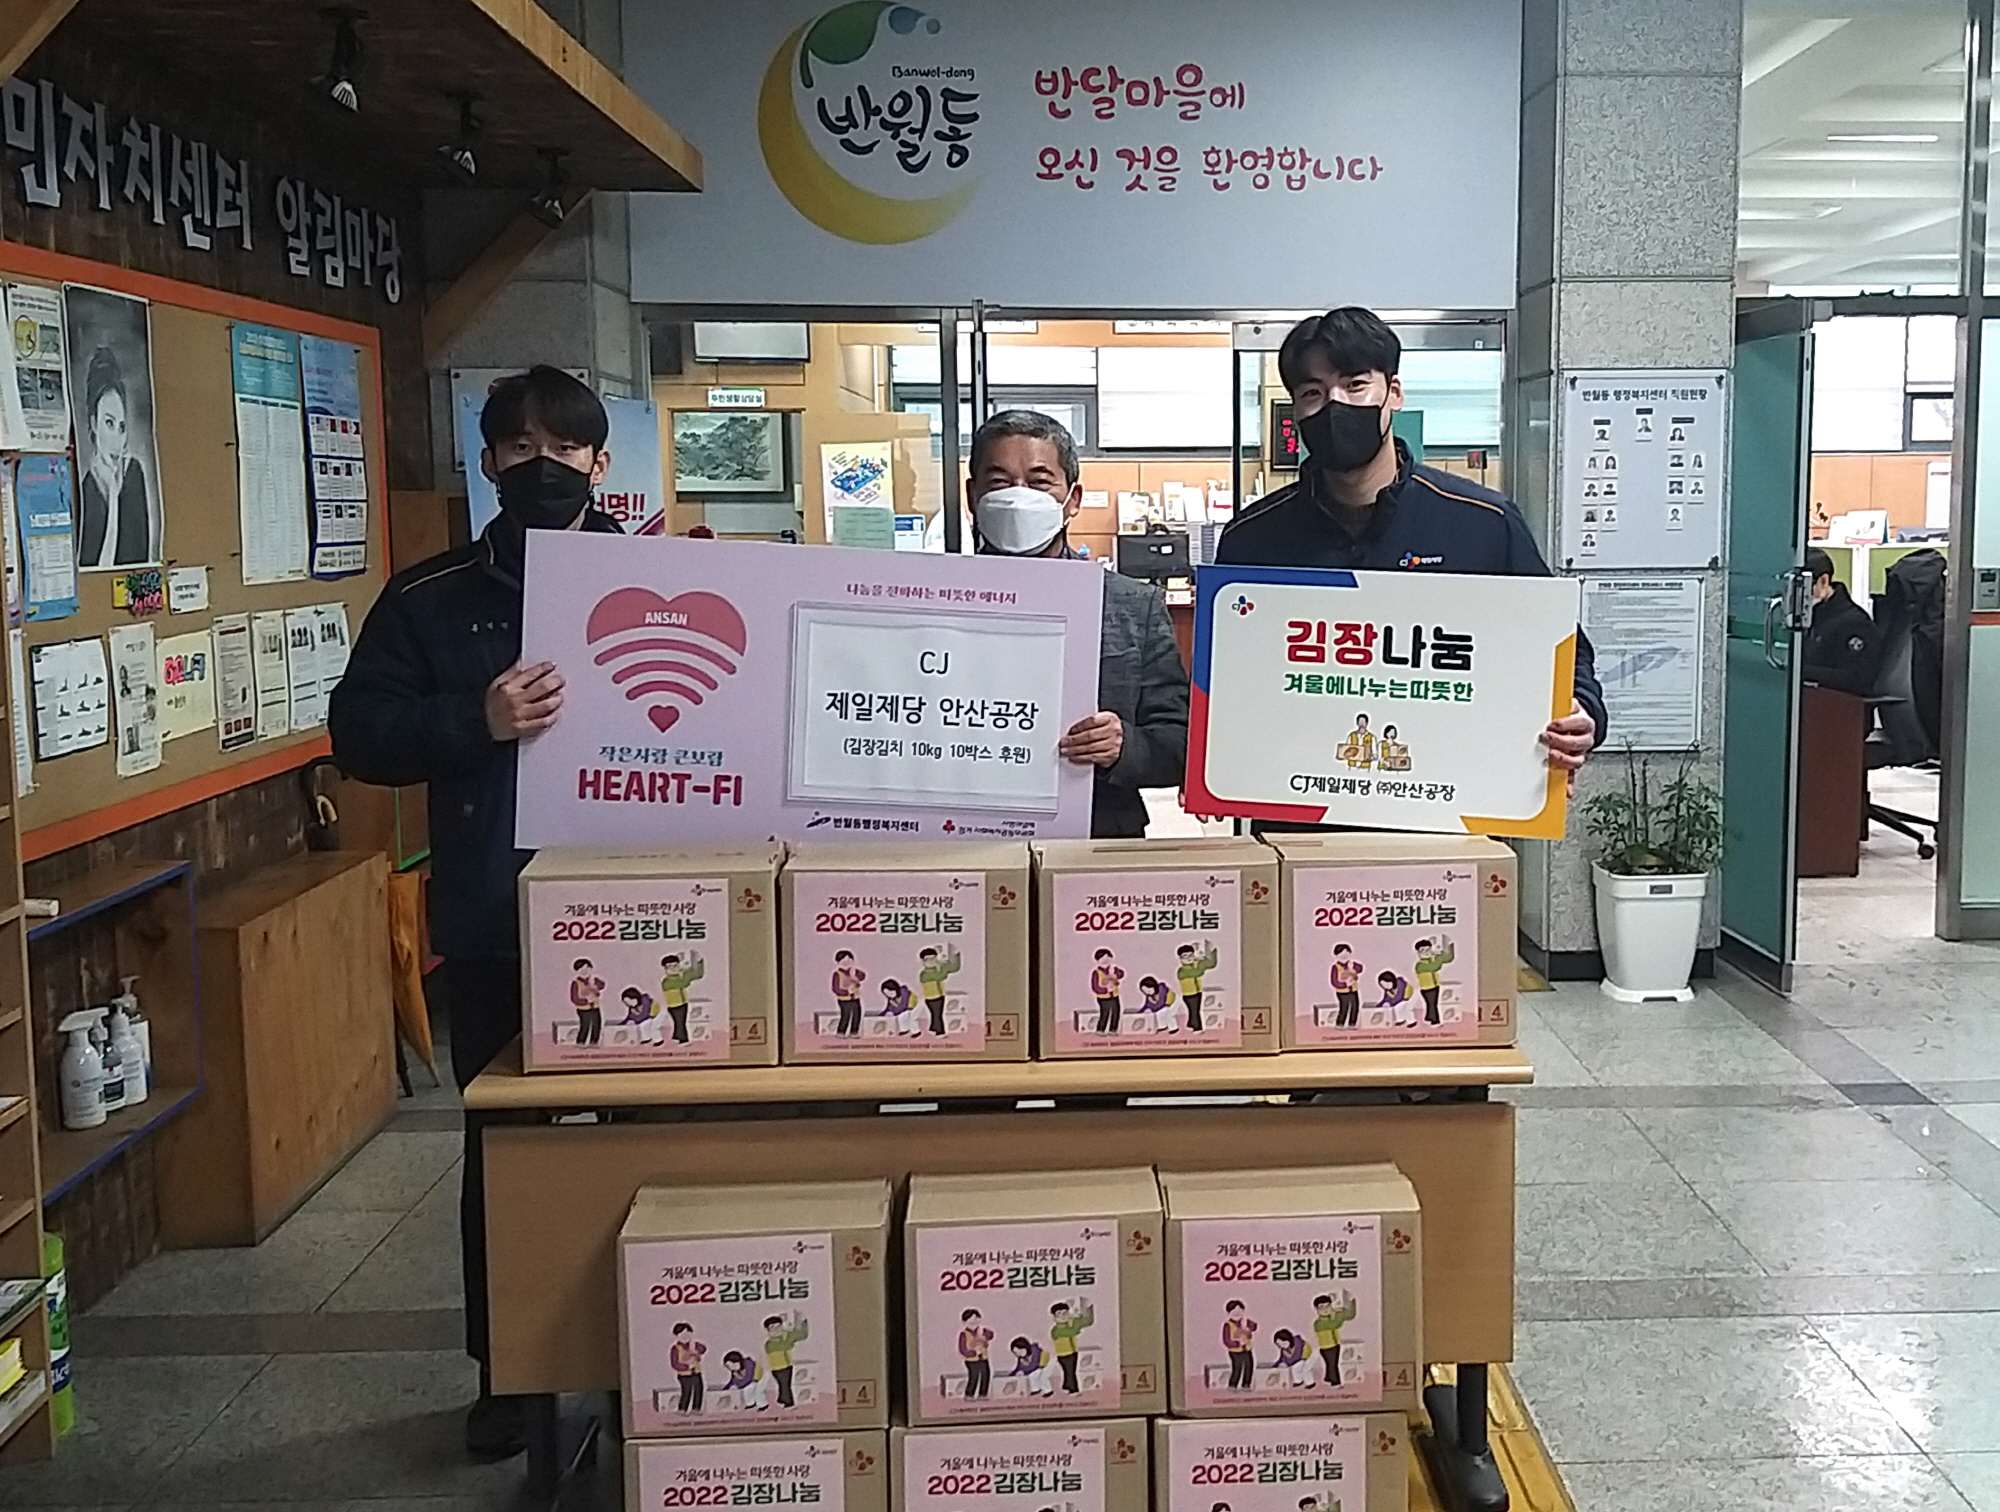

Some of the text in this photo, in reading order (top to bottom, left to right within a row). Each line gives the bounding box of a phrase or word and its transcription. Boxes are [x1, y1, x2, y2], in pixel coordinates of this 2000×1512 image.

[892, 66, 975, 81] Banwol-dong
[1035, 63, 1245, 120] 반달마을에
[817, 84, 980, 174] 반월동
[1036, 145, 1383, 192] 오신 것을 환영합니다
[276, 175, 402, 303] 알림마당
[645, 612, 688, 625] ANSAN
[1285, 620, 1474, 671] 김장나눔
[920, 651, 949, 675] CJ
[1284, 672, 1474, 702] 겨울에나누는따뜻한
[825, 691, 1039, 731] 제일제당 안산공장
[599, 745, 724, 767] 작은사랑 큰보람
[843, 737, 1031, 765] (김장김치 10kg 10박스 후원)
[578, 768, 743, 806] HEART-FI
[1289, 774, 1371, 796] CJ제일제당
[816, 912, 963, 933] 2022 김장나눔
[1075, 910, 1219, 931] 2022 김장나눔
[1314, 904, 1456, 926] 2022 김장나눔
[553, 919, 706, 941] 2022 김장나눔
[940, 1266, 1096, 1291] 2022 김장나눔
[1205, 1258, 1358, 1281] 2022 김장나눔
[650, 1279, 809, 1305] 2022 김장나눔
[928, 1471, 1083, 1495] 2022 김장나눔
[1192, 1460, 1344, 1485] 2022 김장나눔
[663, 1482, 821, 1508] 2022 김장나눔
